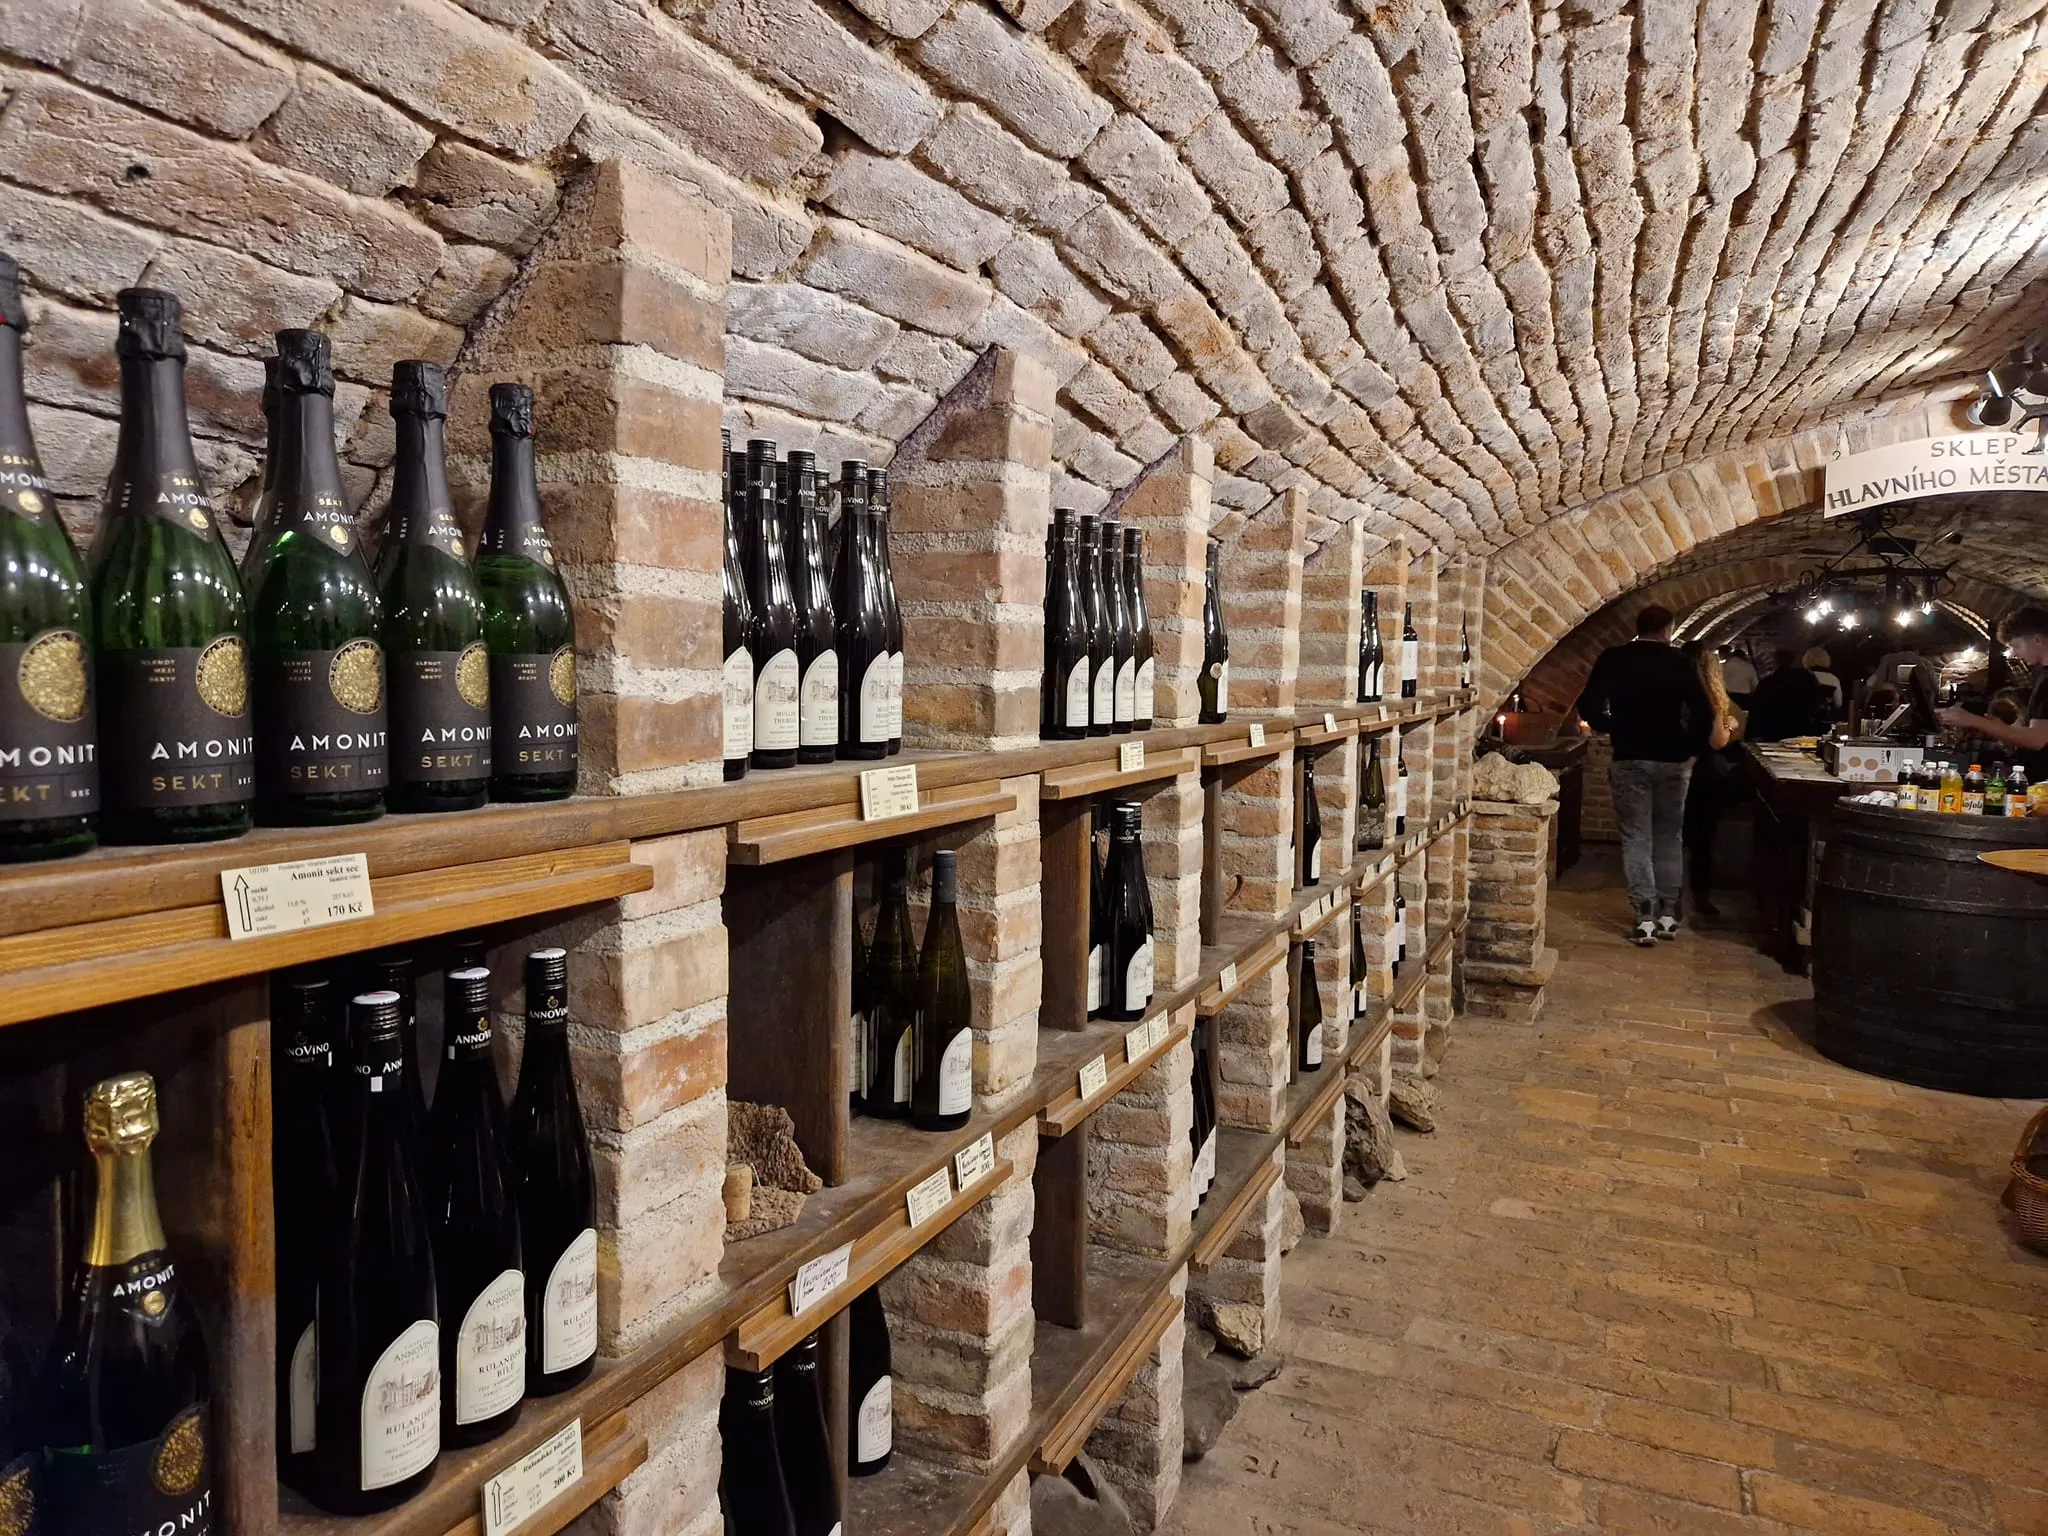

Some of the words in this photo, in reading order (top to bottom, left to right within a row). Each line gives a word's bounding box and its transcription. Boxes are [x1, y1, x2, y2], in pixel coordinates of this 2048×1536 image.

[1930, 437, 2018, 457] SKLEP
[1827, 465, 1957, 510] HLAVNÍHO
[151, 736, 254, 760] AMONIT
[290, 732, 386, 751] AMONIT
[421, 754, 473, 769] SEKT
[519, 750, 564, 763] SEKT
[291, 765, 352, 779] SEKT
[152, 774, 222, 791] SEKT
[291, 868, 323, 880] Amonit
[326, 865, 343, 876] sekt
[328, 904, 345, 917] 170
[348, 901, 363, 913] Kč
[113, 1264, 175, 1298] AMONIT
